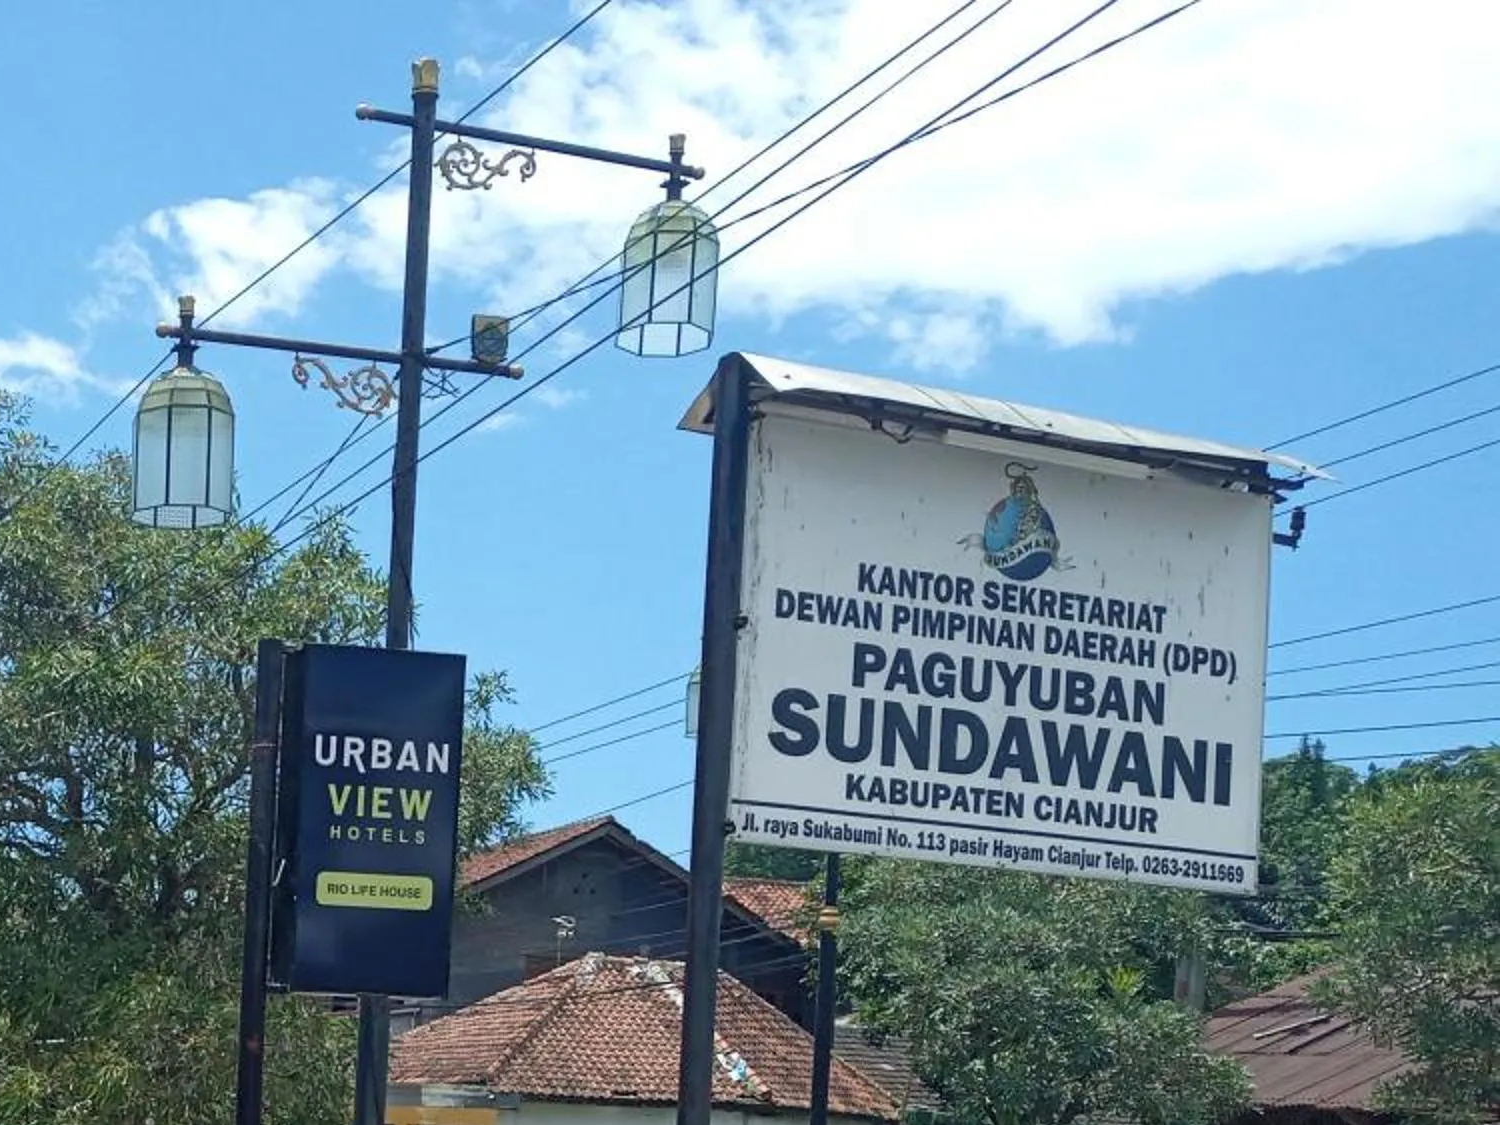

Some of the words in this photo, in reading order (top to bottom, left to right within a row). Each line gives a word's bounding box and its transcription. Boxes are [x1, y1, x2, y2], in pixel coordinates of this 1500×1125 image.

[858, 562, 975, 607] KANTOR
[983, 582, 1166, 634] SEKRETARIAT
[775, 588, 882, 632] DEWAN
[892, 604, 1036, 652] PIMPINAN
[1044, 625, 1156, 668] DAERAH
[1163, 643, 1237, 685] (DPD)
[852, 643, 1165, 726] PAGUYUBAN
[315, 734, 449, 773] URBAN
[768, 688, 1232, 806] SUNDAWANI
[328, 784, 432, 821] VIEW
[846, 774, 1025, 820] KABUPATEN
[1034, 794, 1158, 834] CIANJUR
[330, 824, 426, 845] HOTELS
[764, 819, 798, 839] raya
[803, 818, 882, 846] Sukabumi
[886, 829, 912, 849] No.
[917, 832, 945, 850] 113
[950, 836, 989, 856] pasir
[993, 839, 1043, 863] Hayam
[1048, 845, 1100, 871] Cianjur
[1105, 851, 1138, 875] Telp.
[327, 883, 348, 896] RIO
[350, 884, 376, 898] LIFE
[380, 886, 422, 899] HOUSE
